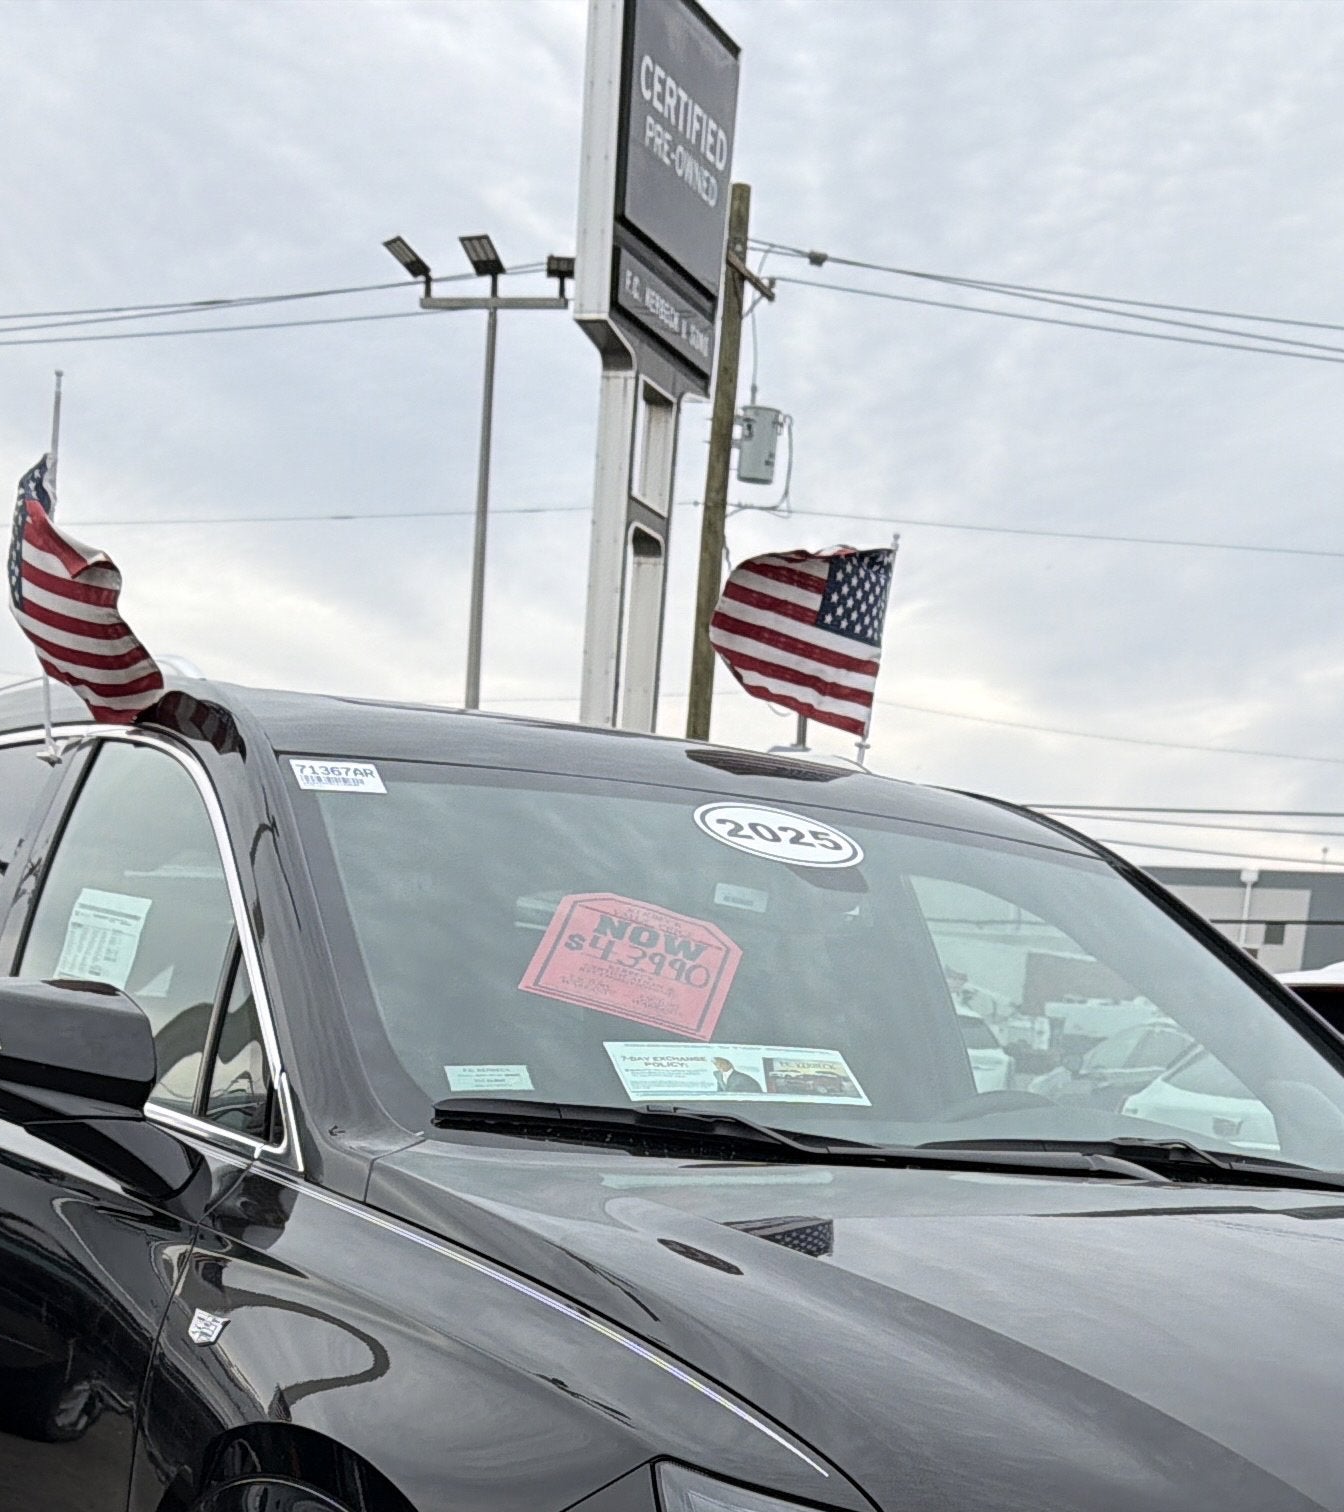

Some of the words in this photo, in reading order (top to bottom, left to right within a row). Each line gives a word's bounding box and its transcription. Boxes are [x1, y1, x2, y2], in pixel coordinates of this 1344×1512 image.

[640, 55, 728, 172] CERTIFIED
[644, 115, 718, 208] PRE-OWNED
[716, 818, 843, 851] 2025
[593, 914, 710, 962] NOW
[652, 1055, 706, 1063] EXCHANGE
